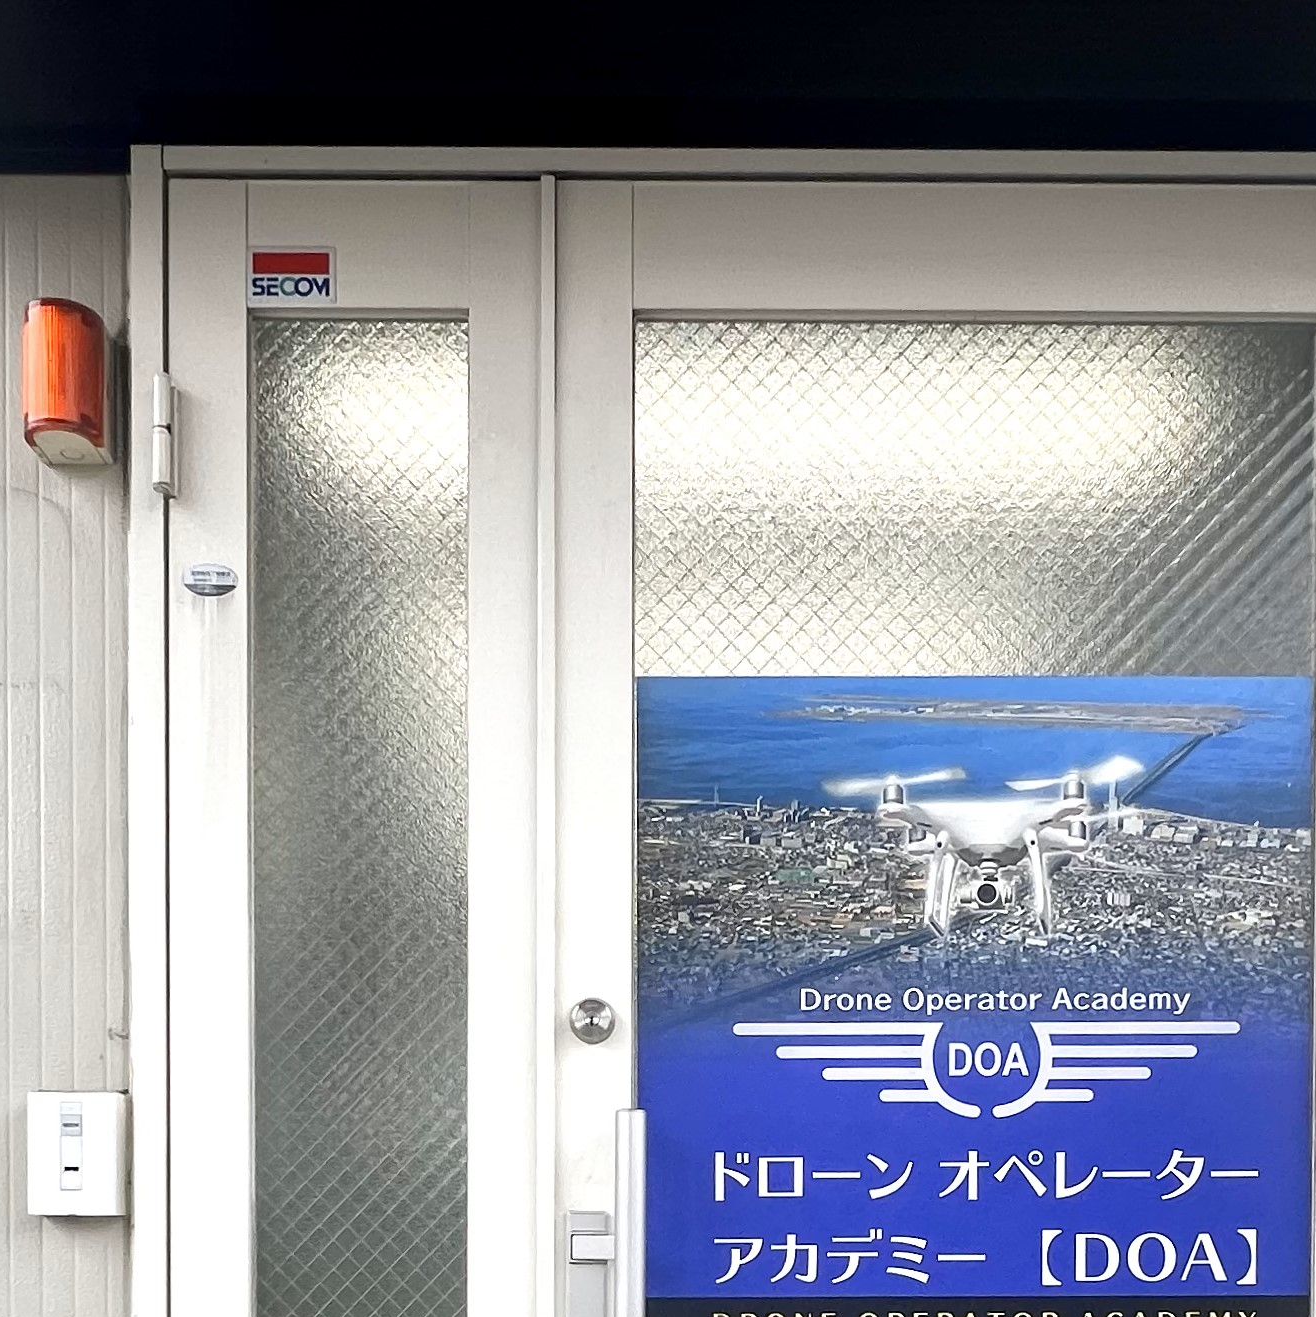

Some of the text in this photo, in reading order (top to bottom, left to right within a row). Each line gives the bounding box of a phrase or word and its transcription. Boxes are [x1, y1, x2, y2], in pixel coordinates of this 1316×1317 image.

[251, 276, 331, 297] SECOM
[799, 986, 1192, 1016] Drone Operator Academy
[947, 1041, 1030, 1078] DOA
[713, 1148, 1260, 1202] ドローン オペレーター
[712, 1228, 1258, 1286] アカデミー 【DOA】
